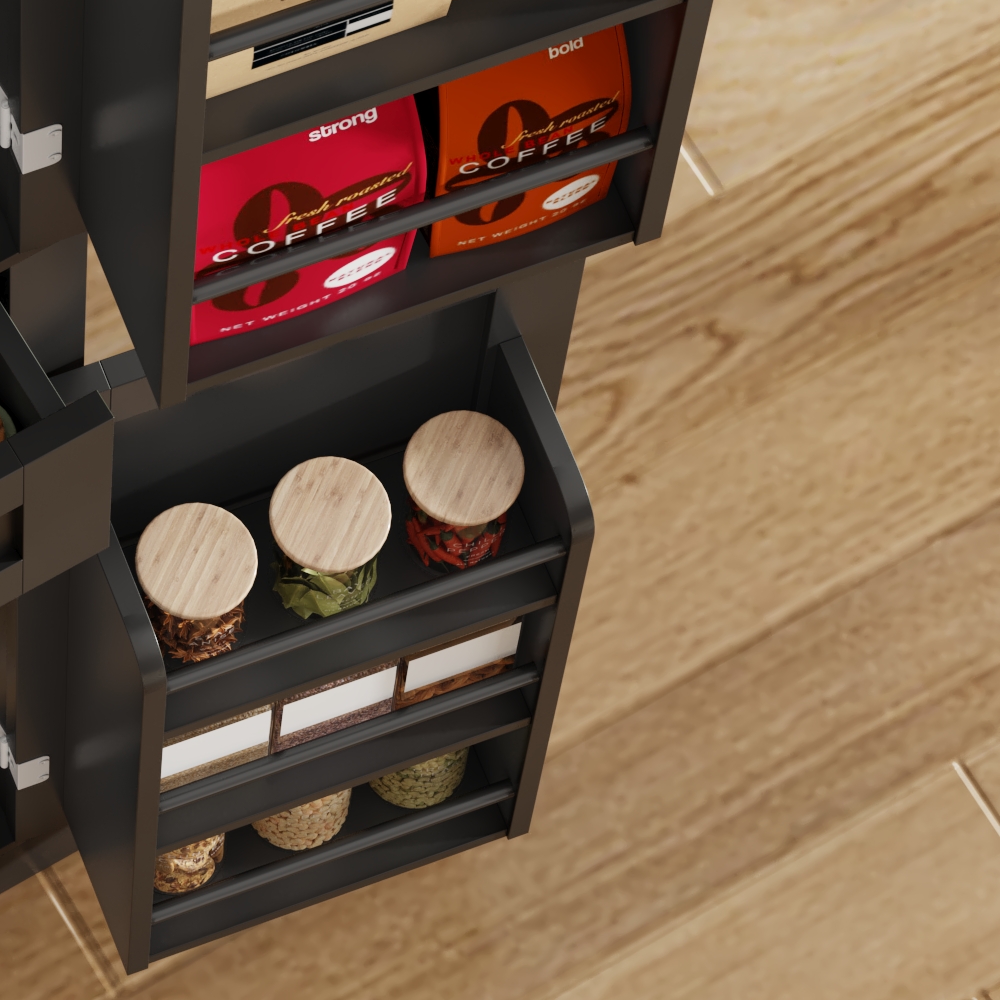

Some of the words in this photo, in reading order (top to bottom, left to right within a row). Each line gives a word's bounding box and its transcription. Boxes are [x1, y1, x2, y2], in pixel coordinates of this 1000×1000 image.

[548, 37, 584, 60] bold
[308, 107, 379, 143] strong
[449, 145, 515, 165] WHOLE
[524, 125, 574, 148] BEAN
[501, 120, 556, 150] fresh
[559, 90, 621, 126] roasted
[458, 116, 607, 175] COFFEE
[263, 198, 332, 234] fresh
[335, 161, 413, 207] roasted
[212, 188, 397, 263] COFFEE
[457, 236, 486, 246] NET
[491, 215, 547, 239] WEIGHT
[220, 320, 255, 332] NET
[262, 293, 331, 322] WEIGHT
[338, 282, 357, 294] 20
